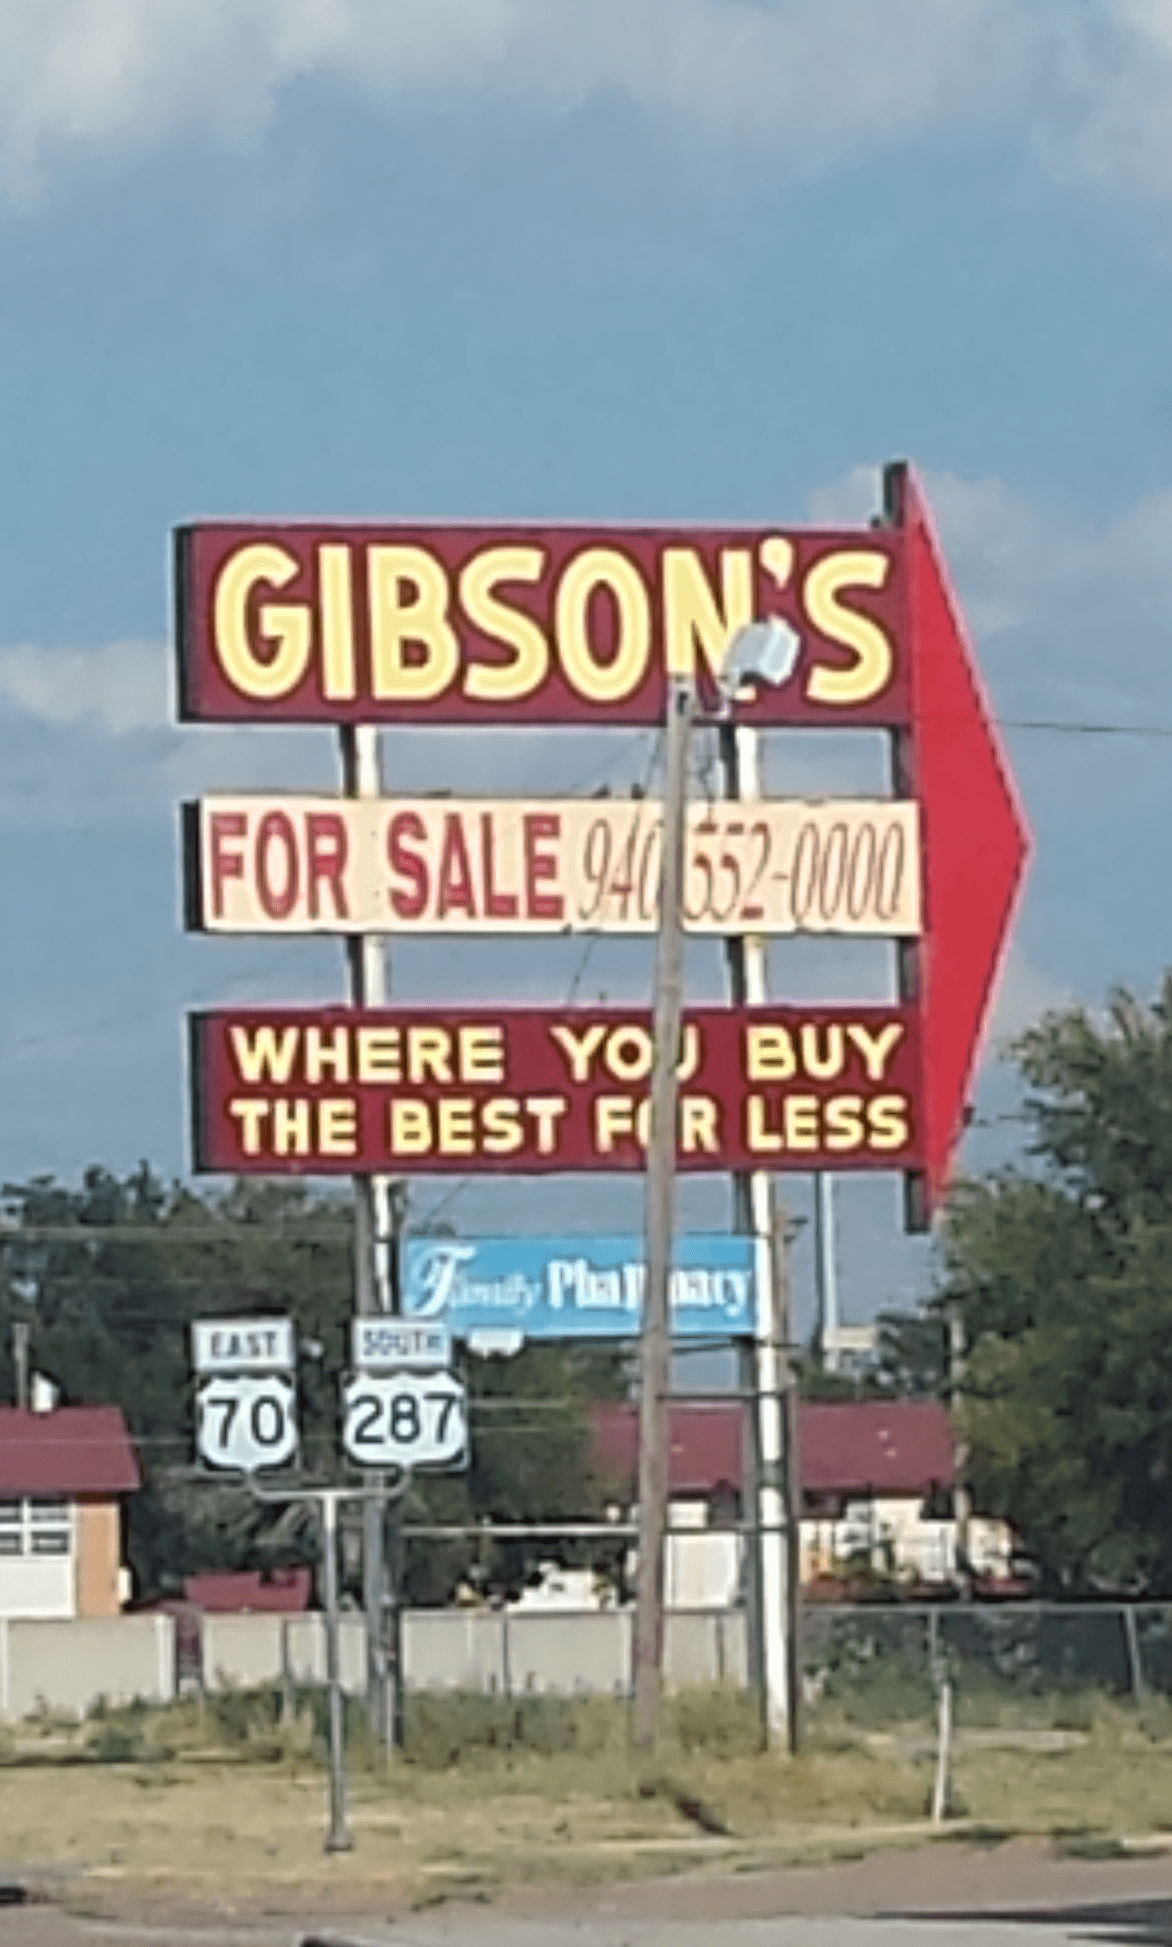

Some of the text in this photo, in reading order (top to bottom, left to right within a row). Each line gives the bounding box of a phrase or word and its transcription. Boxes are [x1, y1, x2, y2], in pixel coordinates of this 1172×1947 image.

[214, 538, 893, 702] GIBSON'S
[208, 812, 351, 919] FOR
[386, 811, 566, 919] SALE
[231, 1026, 505, 1083] WHERE
[747, 1024, 903, 1081] BUY
[230, 1098, 359, 1154] THE
[391, 1097, 567, 1154] BEST
[747, 1095, 909, 1151] LESS
[211, 1331, 277, 1359] EAST
[363, 1330, 443, 1357] SOUTH
[207, 1396, 285, 1448] 70
[350, 1391, 457, 1445] 287
